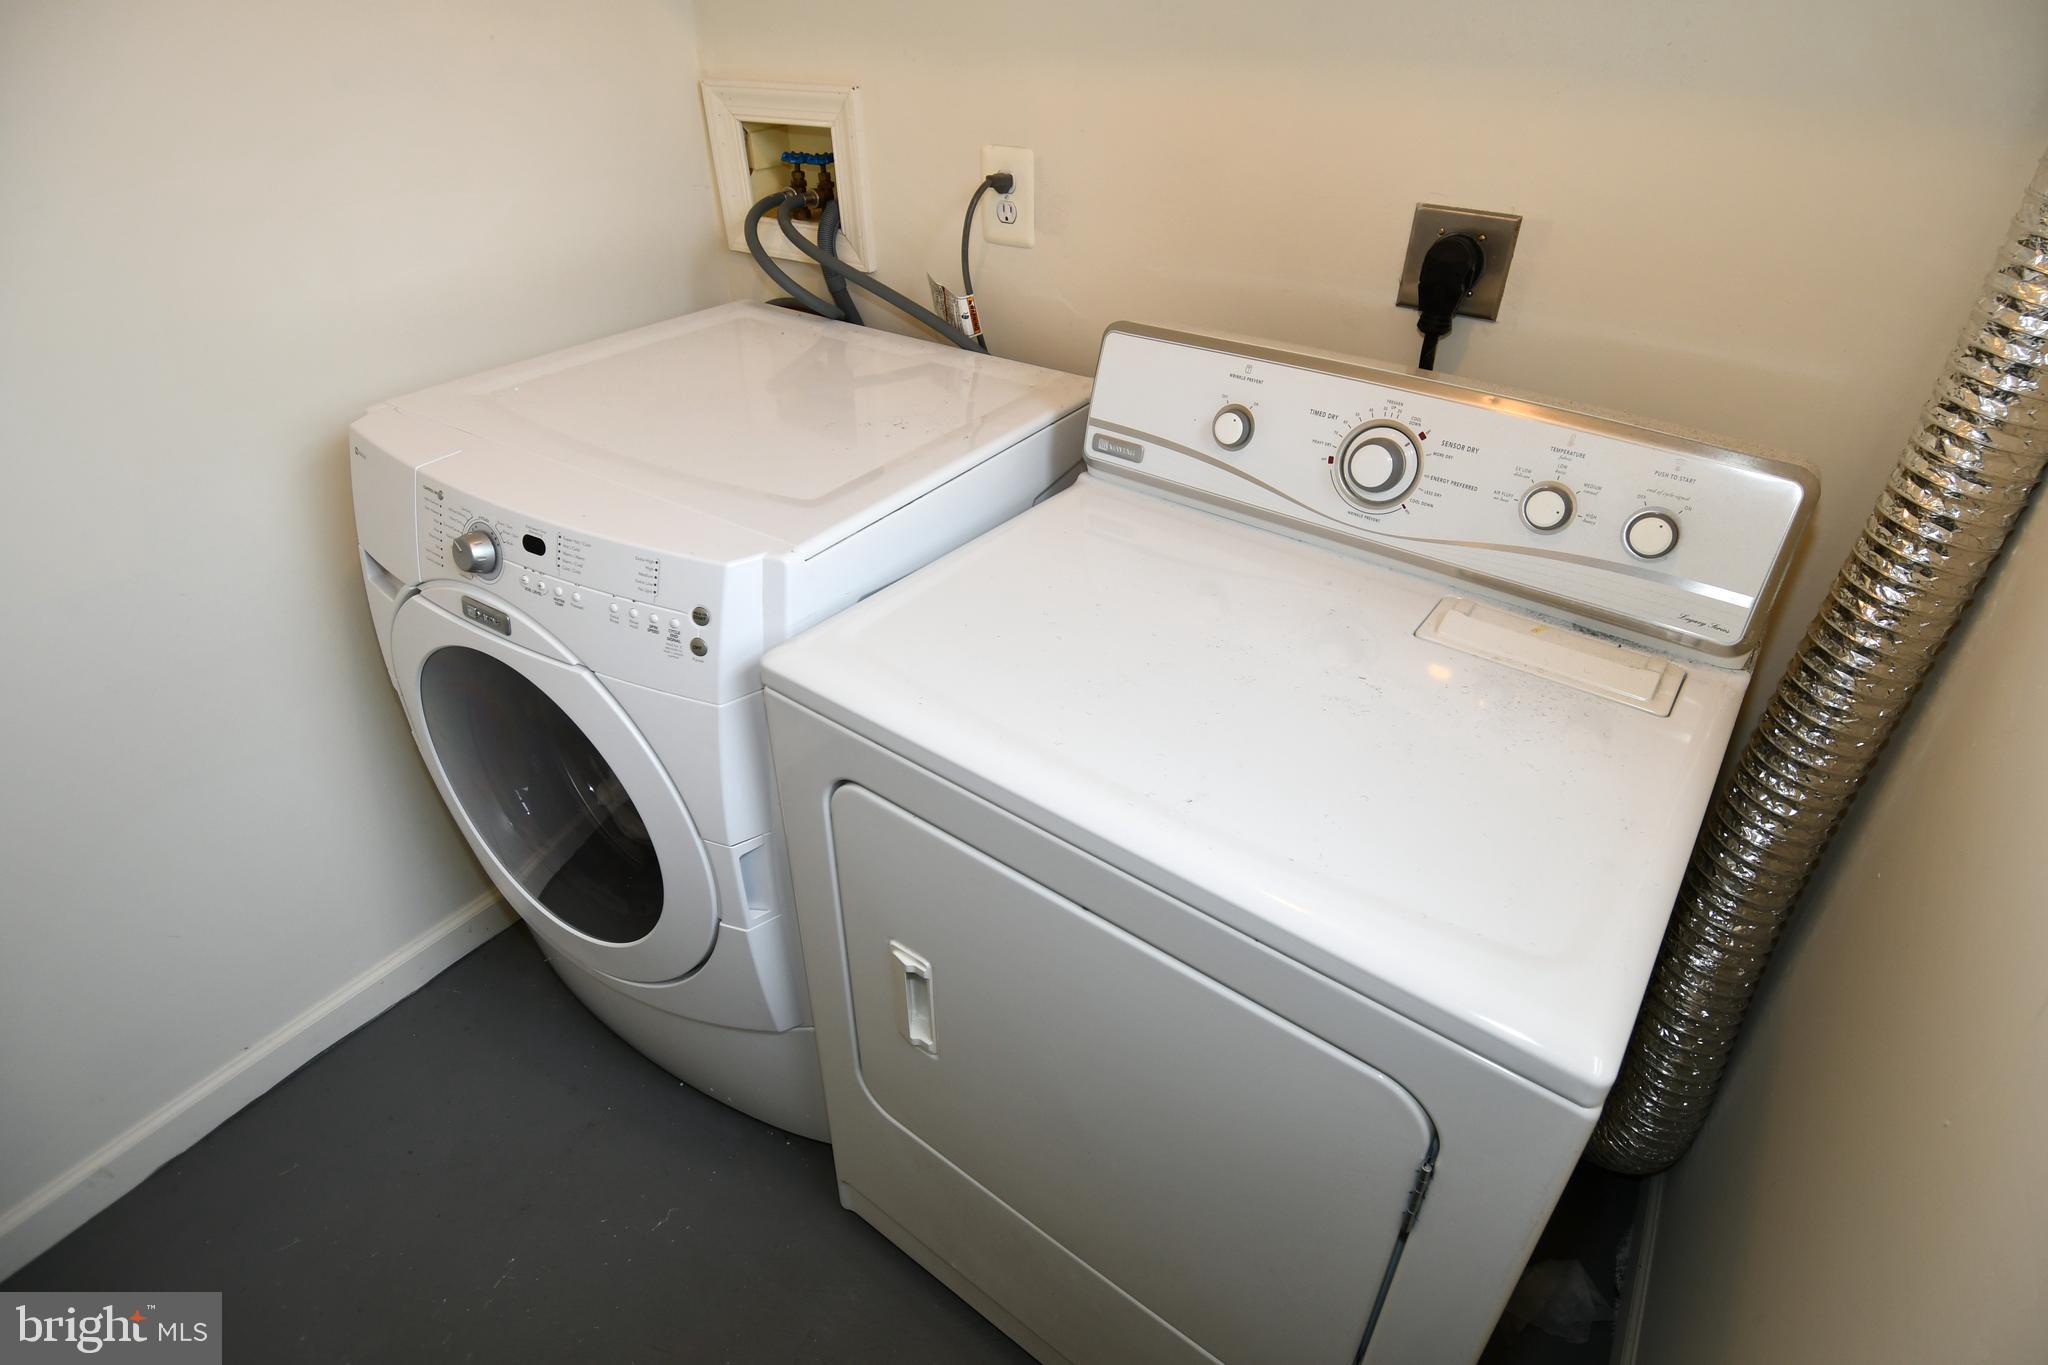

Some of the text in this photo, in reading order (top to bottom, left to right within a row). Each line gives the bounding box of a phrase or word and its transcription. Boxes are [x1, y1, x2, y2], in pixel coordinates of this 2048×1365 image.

[1310, 408, 1339, 420] TIMED DRY
[1441, 440, 1480, 454] SENSOR DRY
[1550, 446, 1586, 459] TEMPERATURE
[1430, 475, 1478, 492] ENERGY PREFERRED
[1654, 470, 1669, 478] PUSH
[1680, 476, 1696, 484] START
